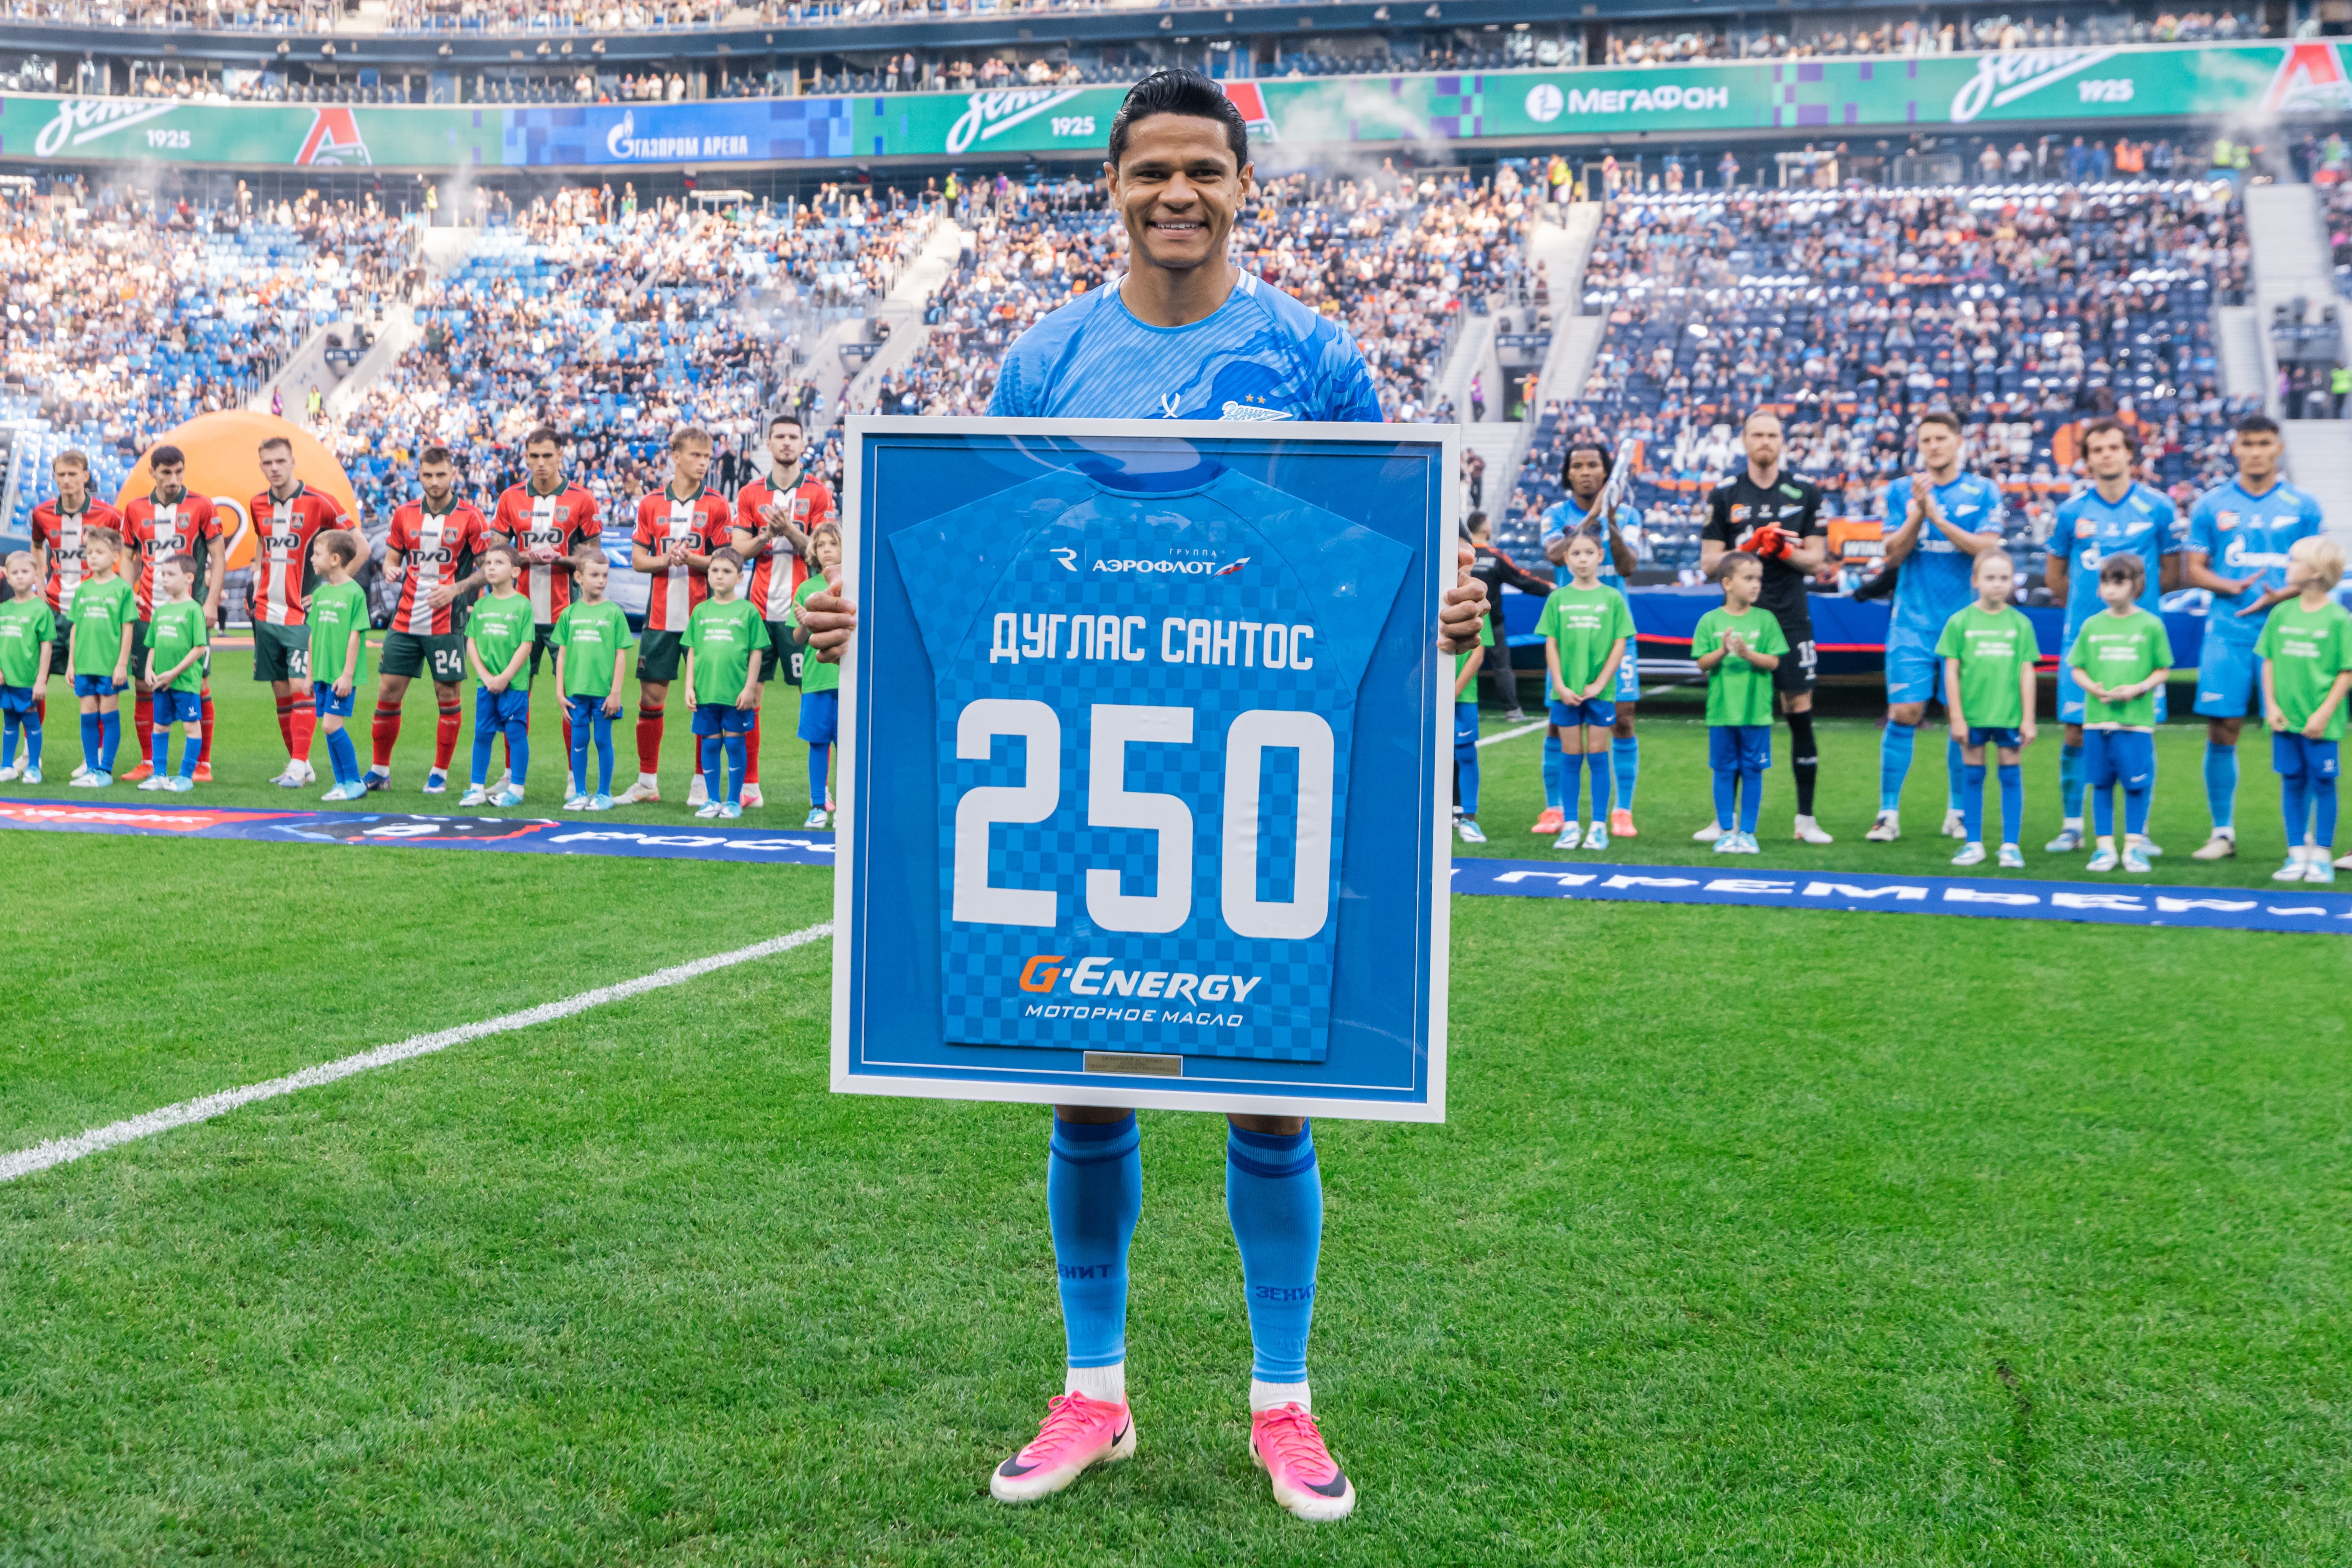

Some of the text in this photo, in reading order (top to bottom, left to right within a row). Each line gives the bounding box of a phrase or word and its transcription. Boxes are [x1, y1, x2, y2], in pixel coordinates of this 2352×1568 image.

[2078, 78, 2134, 103] 1925
[1050, 116, 1096, 136] 1925
[146, 128, 191, 149] 1925
[635, 135, 748, 158] ГАЗПРОМ АРЕНА
[1169, 548, 1217, 556] ГРУППА
[1092, 559, 1215, 575] АЭРОФЛОТ
[990, 612, 1314, 670] ДУГЛАС САНТОС
[435, 649, 462, 674] 24
[952, 698, 1334, 939] 250
[1493, 871, 2352, 918] ПРЕМЬЕР-
[1025, 1004, 1243, 1027] МОТОРНОЕ МАСЛО
